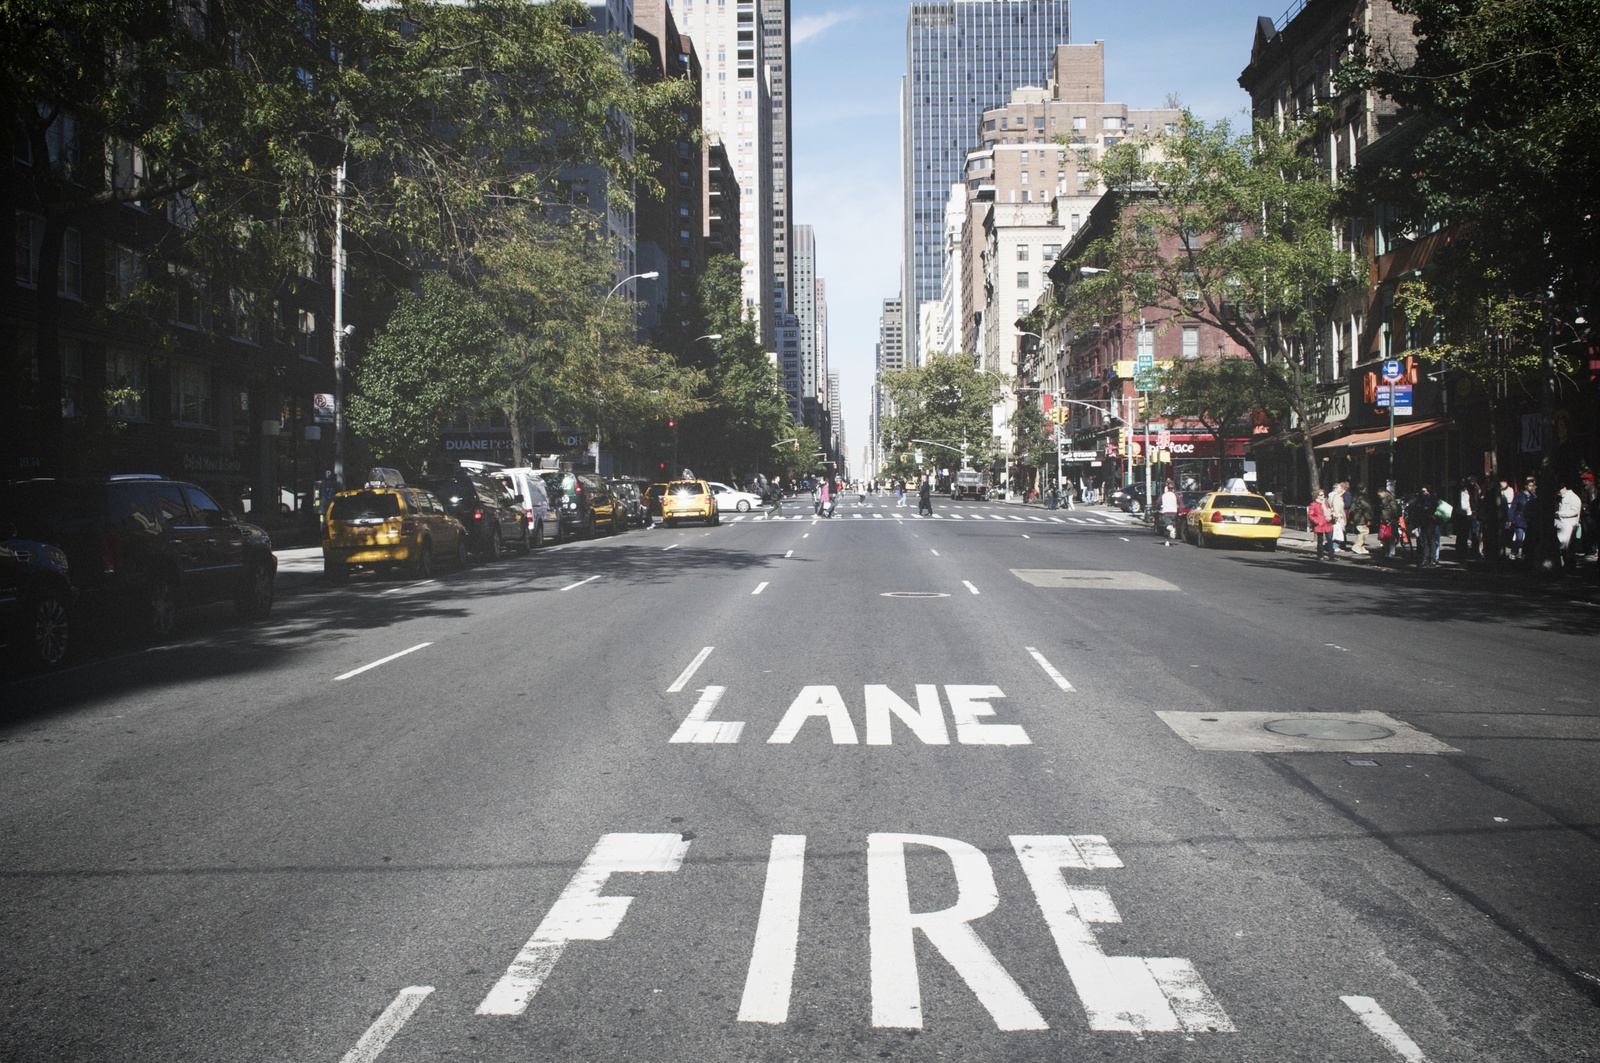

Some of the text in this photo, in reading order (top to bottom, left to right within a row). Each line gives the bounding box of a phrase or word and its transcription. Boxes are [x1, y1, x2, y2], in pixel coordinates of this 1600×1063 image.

[446, 440, 488, 450] DUANE
[1169, 441, 1194, 453] face
[668, 684, 1033, 746] LANE
[474, 833, 1237, 1033] FIRE
